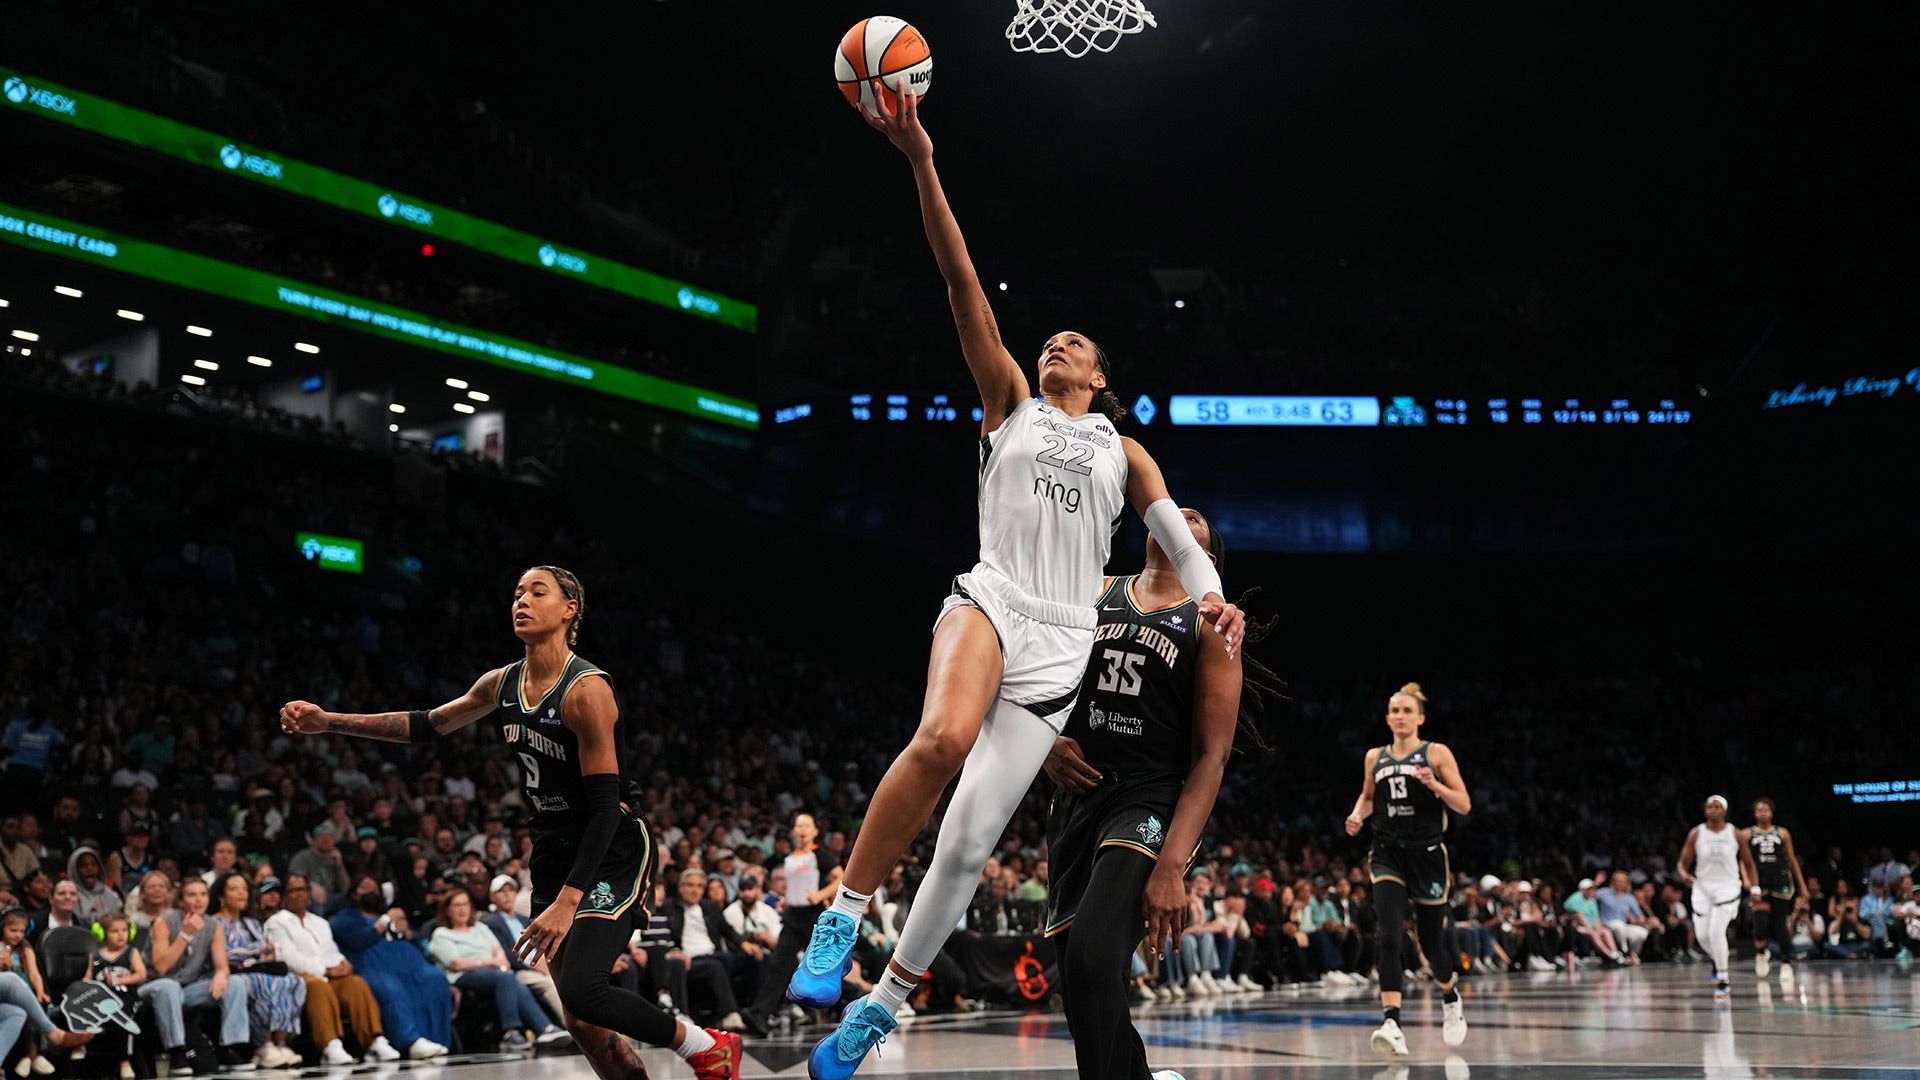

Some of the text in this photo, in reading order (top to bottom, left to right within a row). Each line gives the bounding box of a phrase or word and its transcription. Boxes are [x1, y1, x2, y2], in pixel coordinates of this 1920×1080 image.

[28, 87, 76, 116] XBOX
[241, 153, 284, 179] XBOX
[26, 222, 77, 247] CREDIT
[77, 236, 118, 257] CARD
[1196, 401, 1230, 422] 58
[1271, 403, 1312, 418] 9:48
[1320, 402, 1354, 422] 63
[1033, 417, 1111, 449] ACES
[1095, 424, 1115, 437] ally
[1035, 434, 1095, 477] 22
[1033, 474, 1081, 513] ring
[320, 544, 356, 563] XBOX
[1159, 618, 1187, 633] BARCLAYS
[1135, 625, 1180, 670] YORK
[1097, 647, 1147, 697] 35
[1106, 721, 1143, 736] Mutual
[1108, 711, 1144, 730] Liberty
[526, 727, 567, 762] YORK
[517, 751, 540, 789] 9
[1388, 775, 1408, 800] 13
